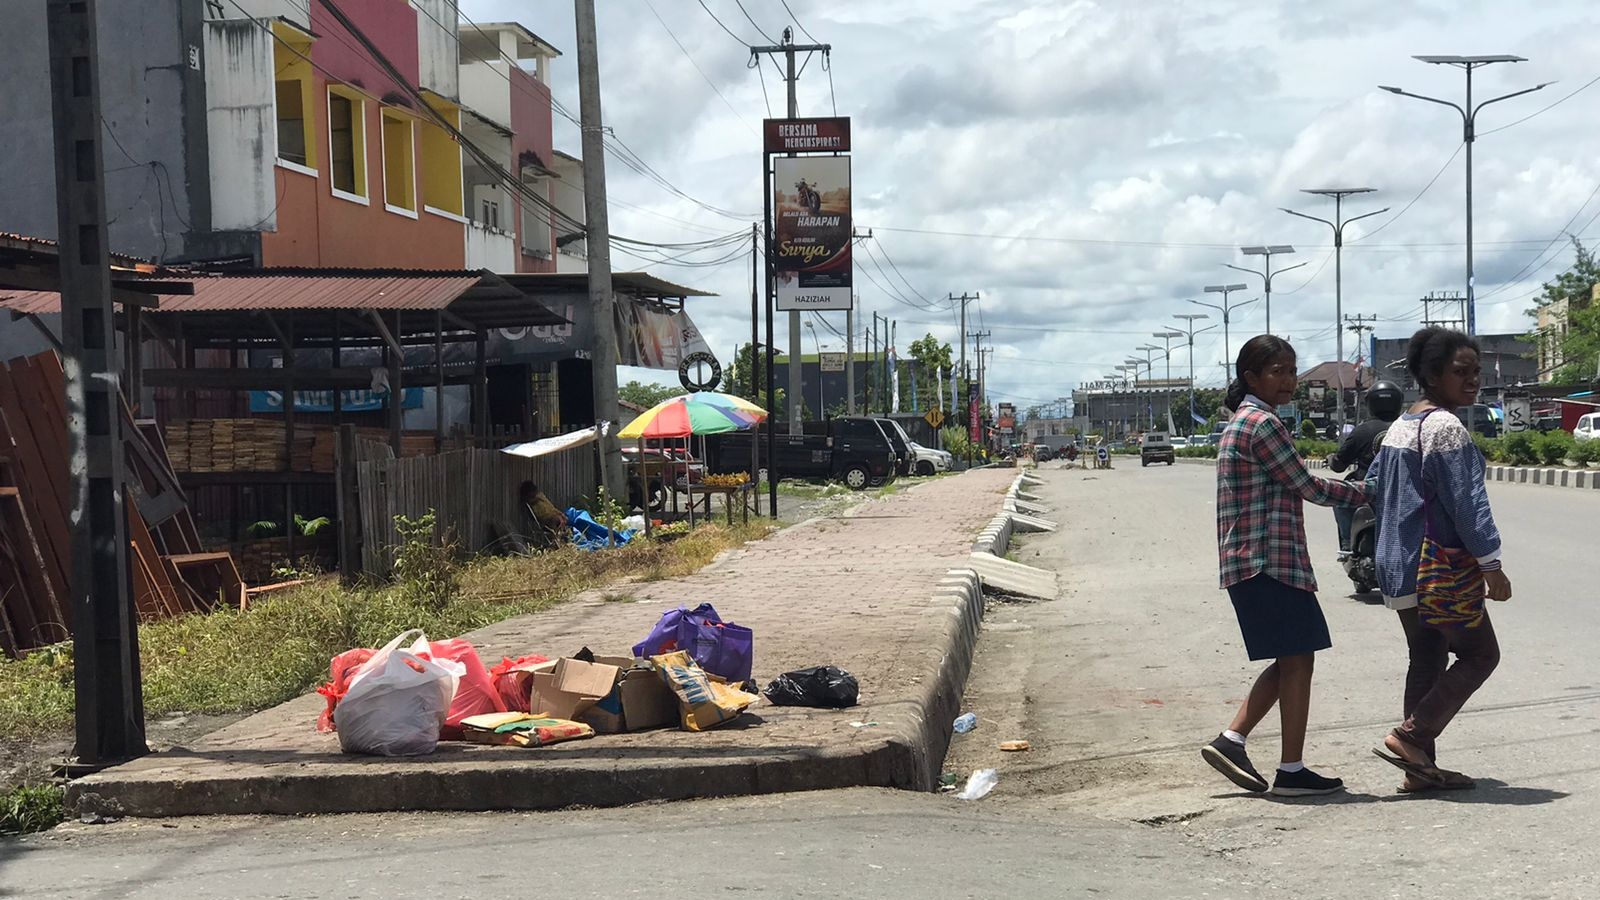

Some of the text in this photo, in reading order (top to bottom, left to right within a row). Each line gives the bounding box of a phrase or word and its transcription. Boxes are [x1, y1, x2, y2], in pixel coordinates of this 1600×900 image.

[778, 124, 818, 137] BERSAMA
[784, 136, 840, 148] MENGINSPIRASI
[797, 216, 840, 227] HARAPAN
[779, 240, 831, 263] Surya
[795, 295, 831, 303] HAZIZIAH
